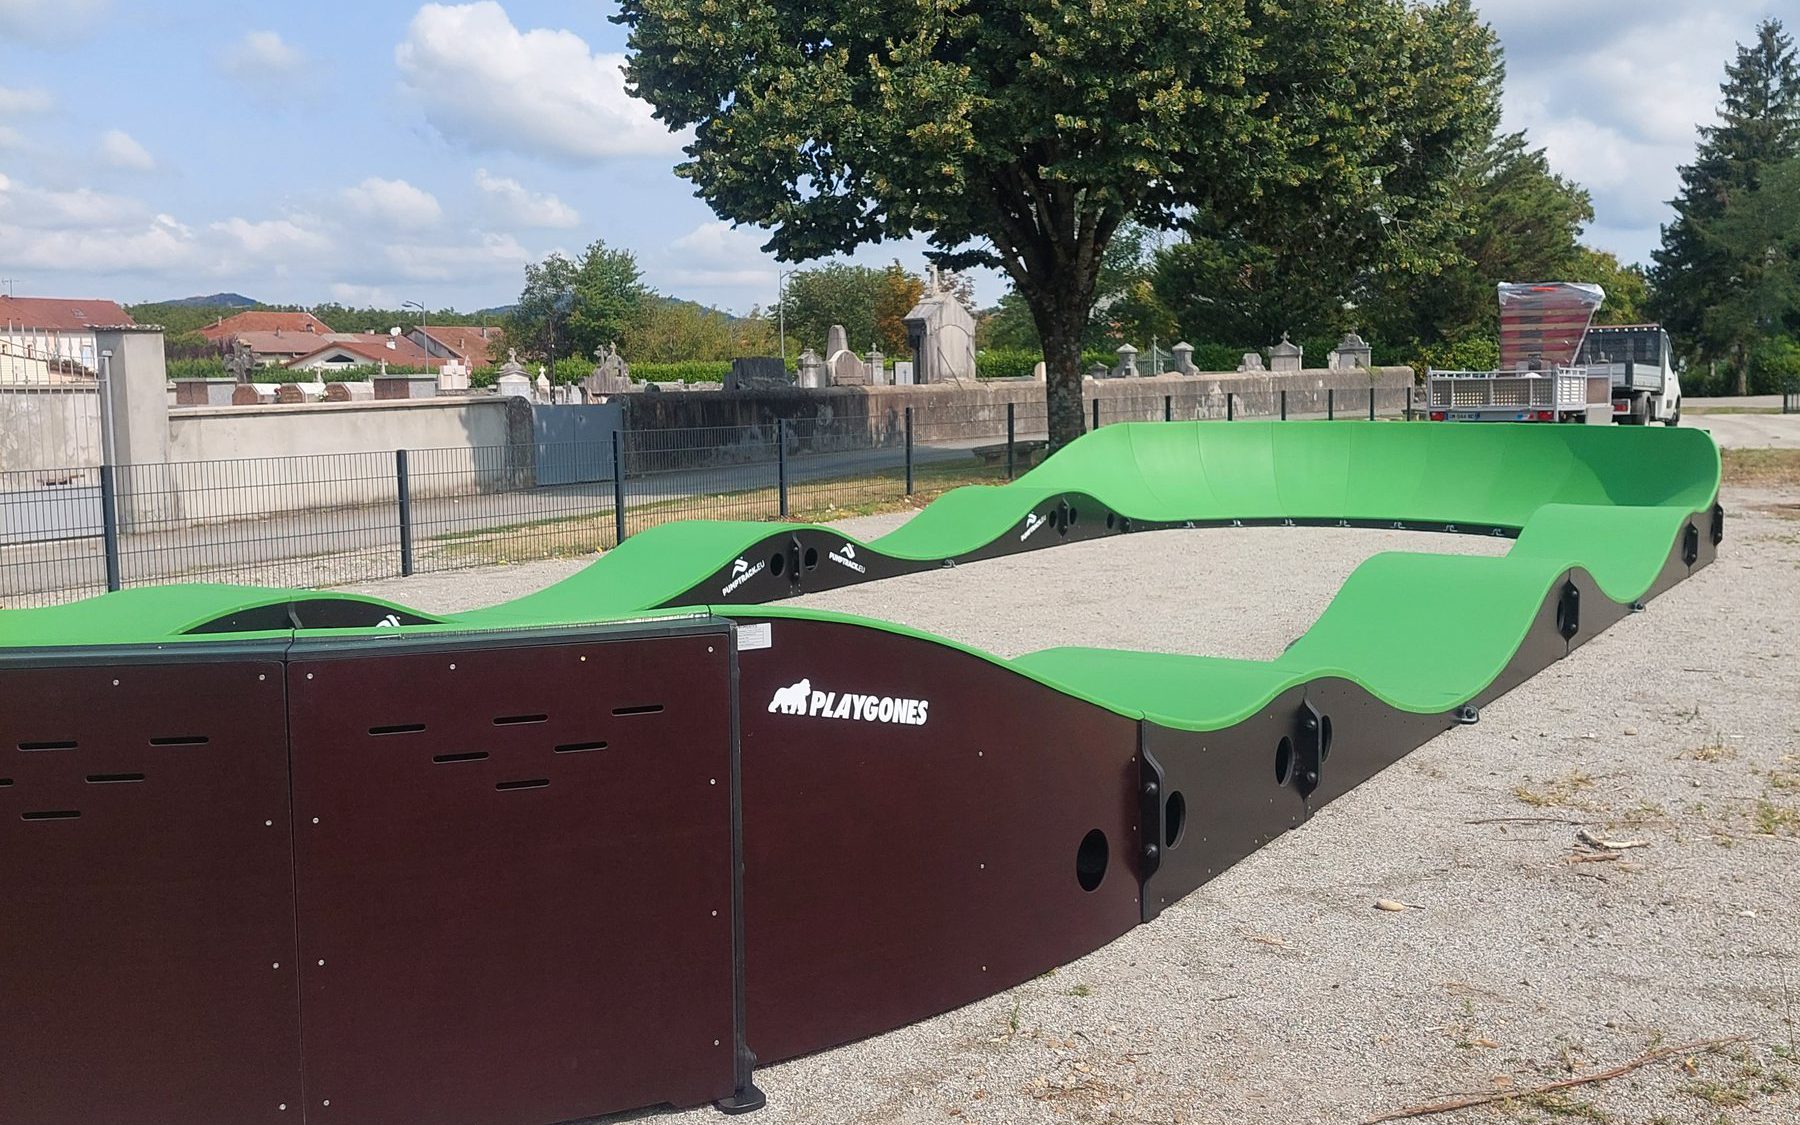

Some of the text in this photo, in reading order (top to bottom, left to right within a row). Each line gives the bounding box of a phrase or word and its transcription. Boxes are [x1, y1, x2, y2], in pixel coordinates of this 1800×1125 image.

[721, 559, 766, 597] PUMPTRACK.EU
[828, 551, 866, 574] PUMPTRACK.EU
[809, 690, 929, 725] PLAYGONES
